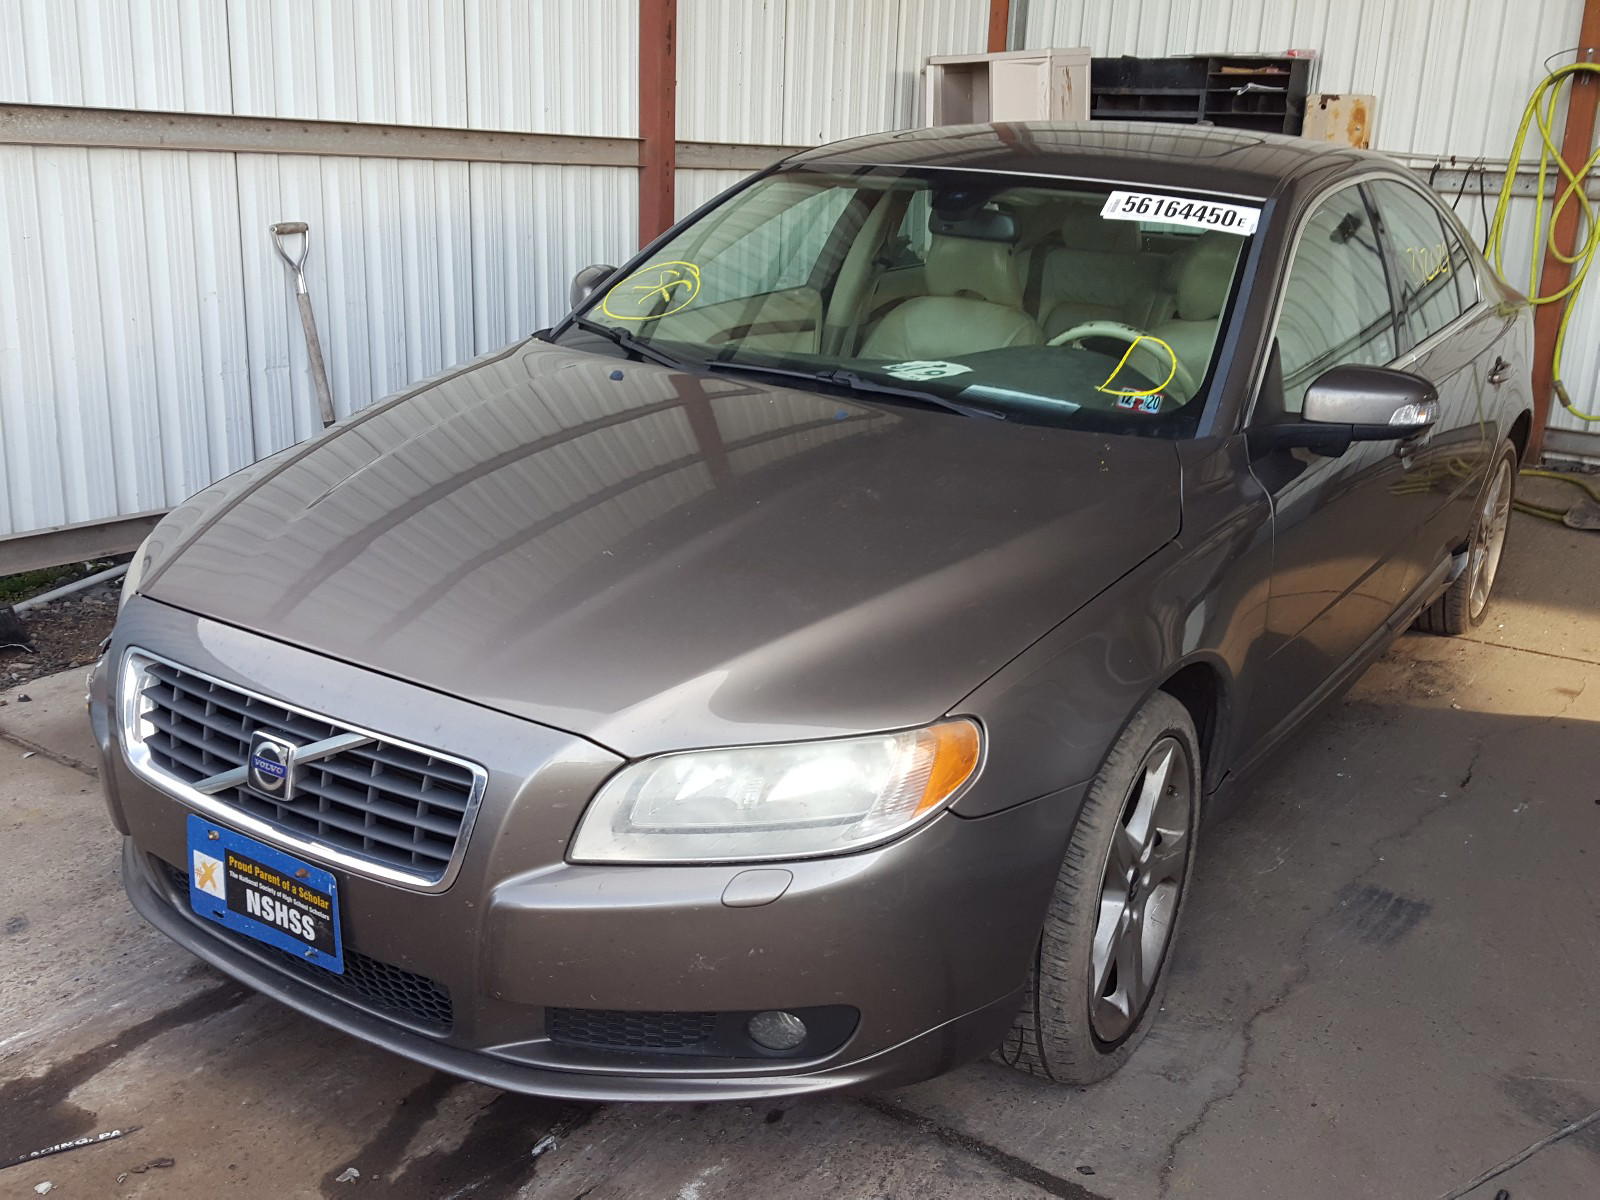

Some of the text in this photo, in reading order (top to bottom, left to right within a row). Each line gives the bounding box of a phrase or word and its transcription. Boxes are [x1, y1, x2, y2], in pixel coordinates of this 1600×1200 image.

[1146, 394, 1161, 410] 20
[254, 758, 284, 775] VOLVO
[228, 855, 330, 910] Proud Parent of a Scholar
[245, 888, 316, 941] NSHSS
